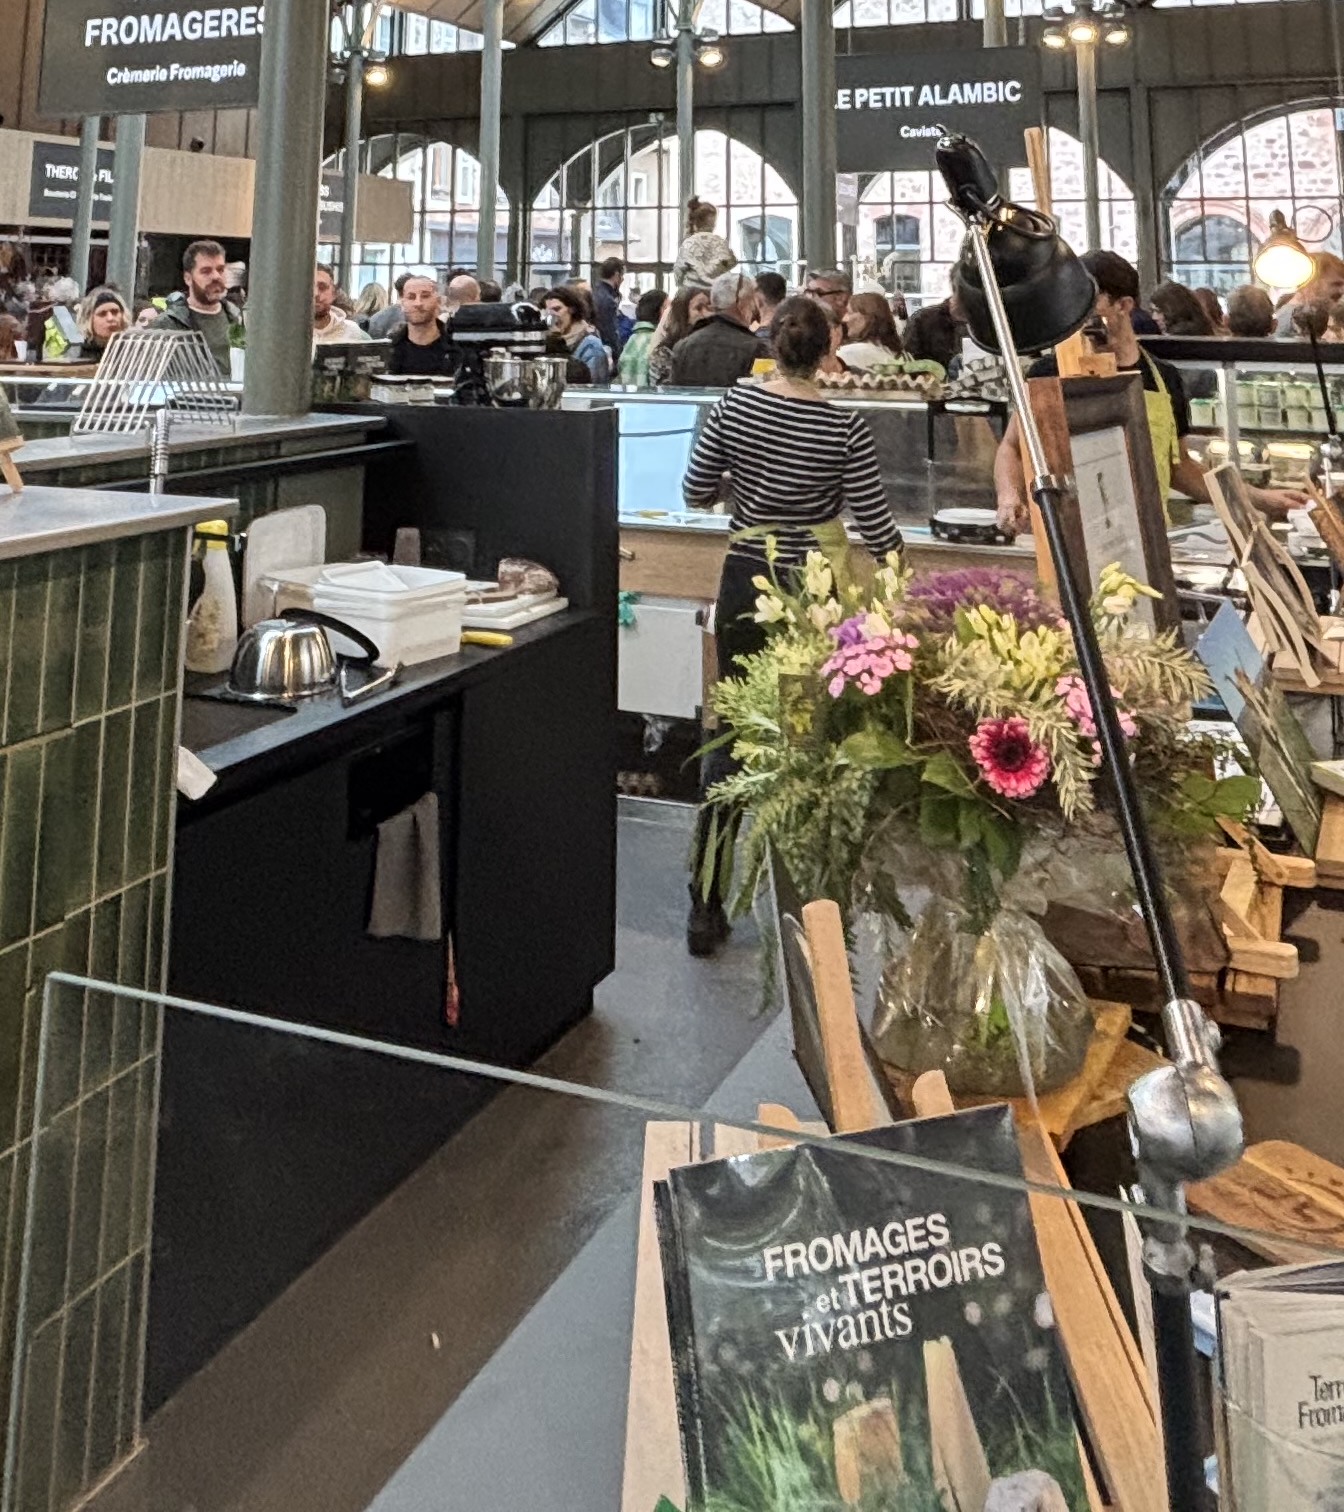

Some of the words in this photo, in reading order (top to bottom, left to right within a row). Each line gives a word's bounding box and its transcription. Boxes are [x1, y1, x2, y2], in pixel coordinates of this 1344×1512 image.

[106, 65, 167, 85] Crèmerie
[169, 59, 246, 83] Fromagerie
[834, 88, 851, 110] E
[855, 85, 914, 109] PETIT
[918, 80, 1021, 107] ALAMBIC
[763, 1213, 950, 1282] FROMAGES
[816, 1287, 841, 1314] et
[838, 1242, 1005, 1307] TERROIRS
[774, 1300, 913, 1362] vivants
